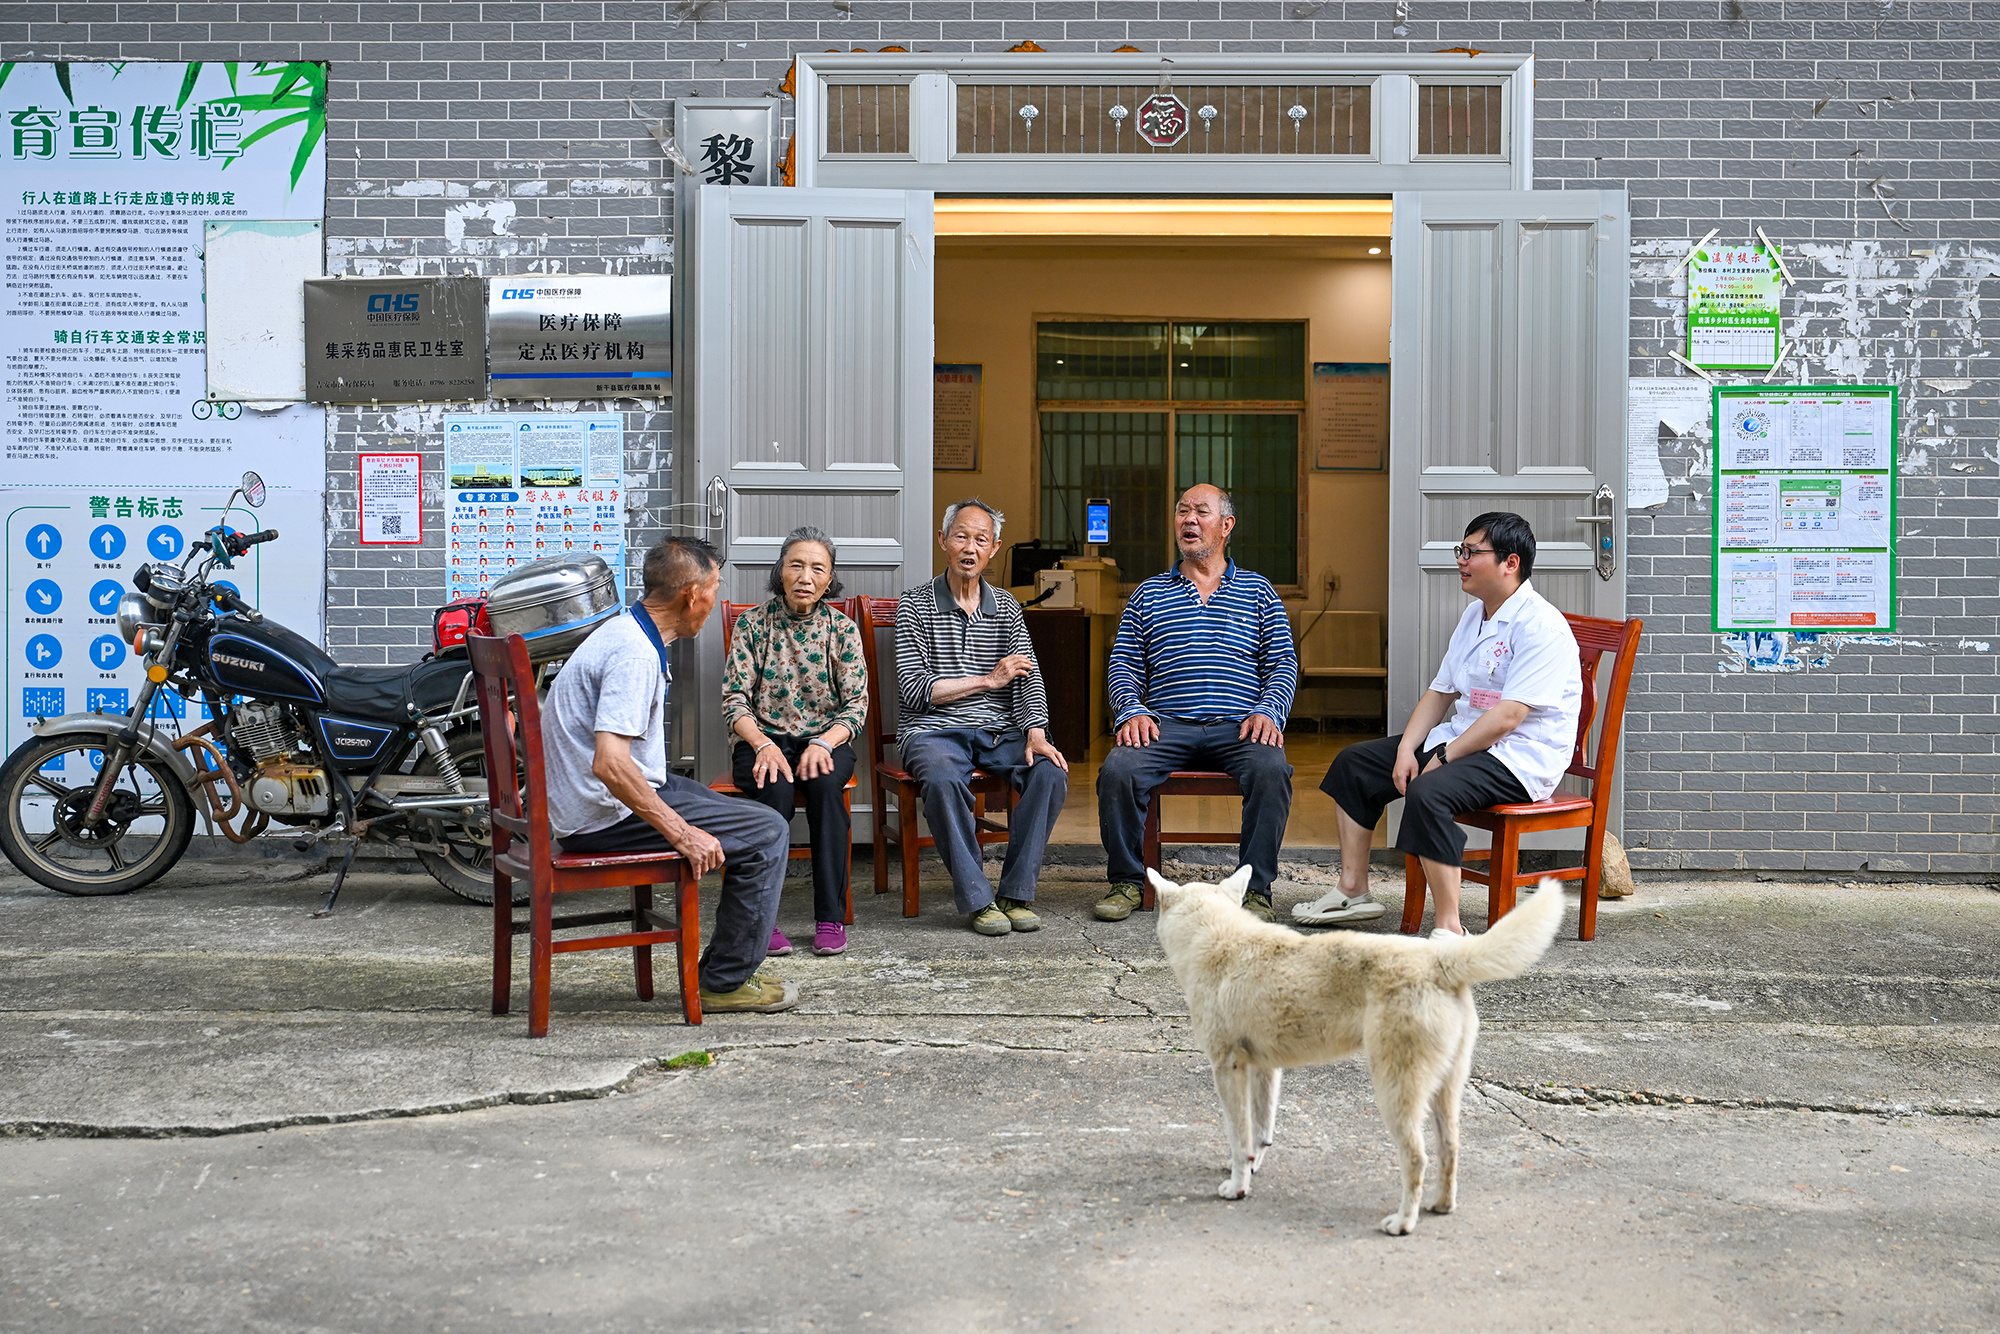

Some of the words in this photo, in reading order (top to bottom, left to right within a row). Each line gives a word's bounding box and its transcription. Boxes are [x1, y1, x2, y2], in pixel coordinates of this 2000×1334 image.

[0, 104, 243, 160] 育宣传栏
[700, 133, 755, 186] 黎
[22, 190, 236, 206] 行人在道路上行走应遵守的规定
[1711, 252, 1761, 265] 温馨提示
[366, 312, 420, 322] 中国医疗保障
[539, 312, 623, 332] 医疗保障
[54, 330, 206, 345] 骑自行车交通安全常识
[325, 340, 464, 360] 集采药品惠民卫生室
[518, 341, 645, 361] 定点医疗机构
[89, 496, 184, 518] 警告标志
[465, 493, 510, 502] 专家介绍
[211, 652, 265, 672] SUZUKI
